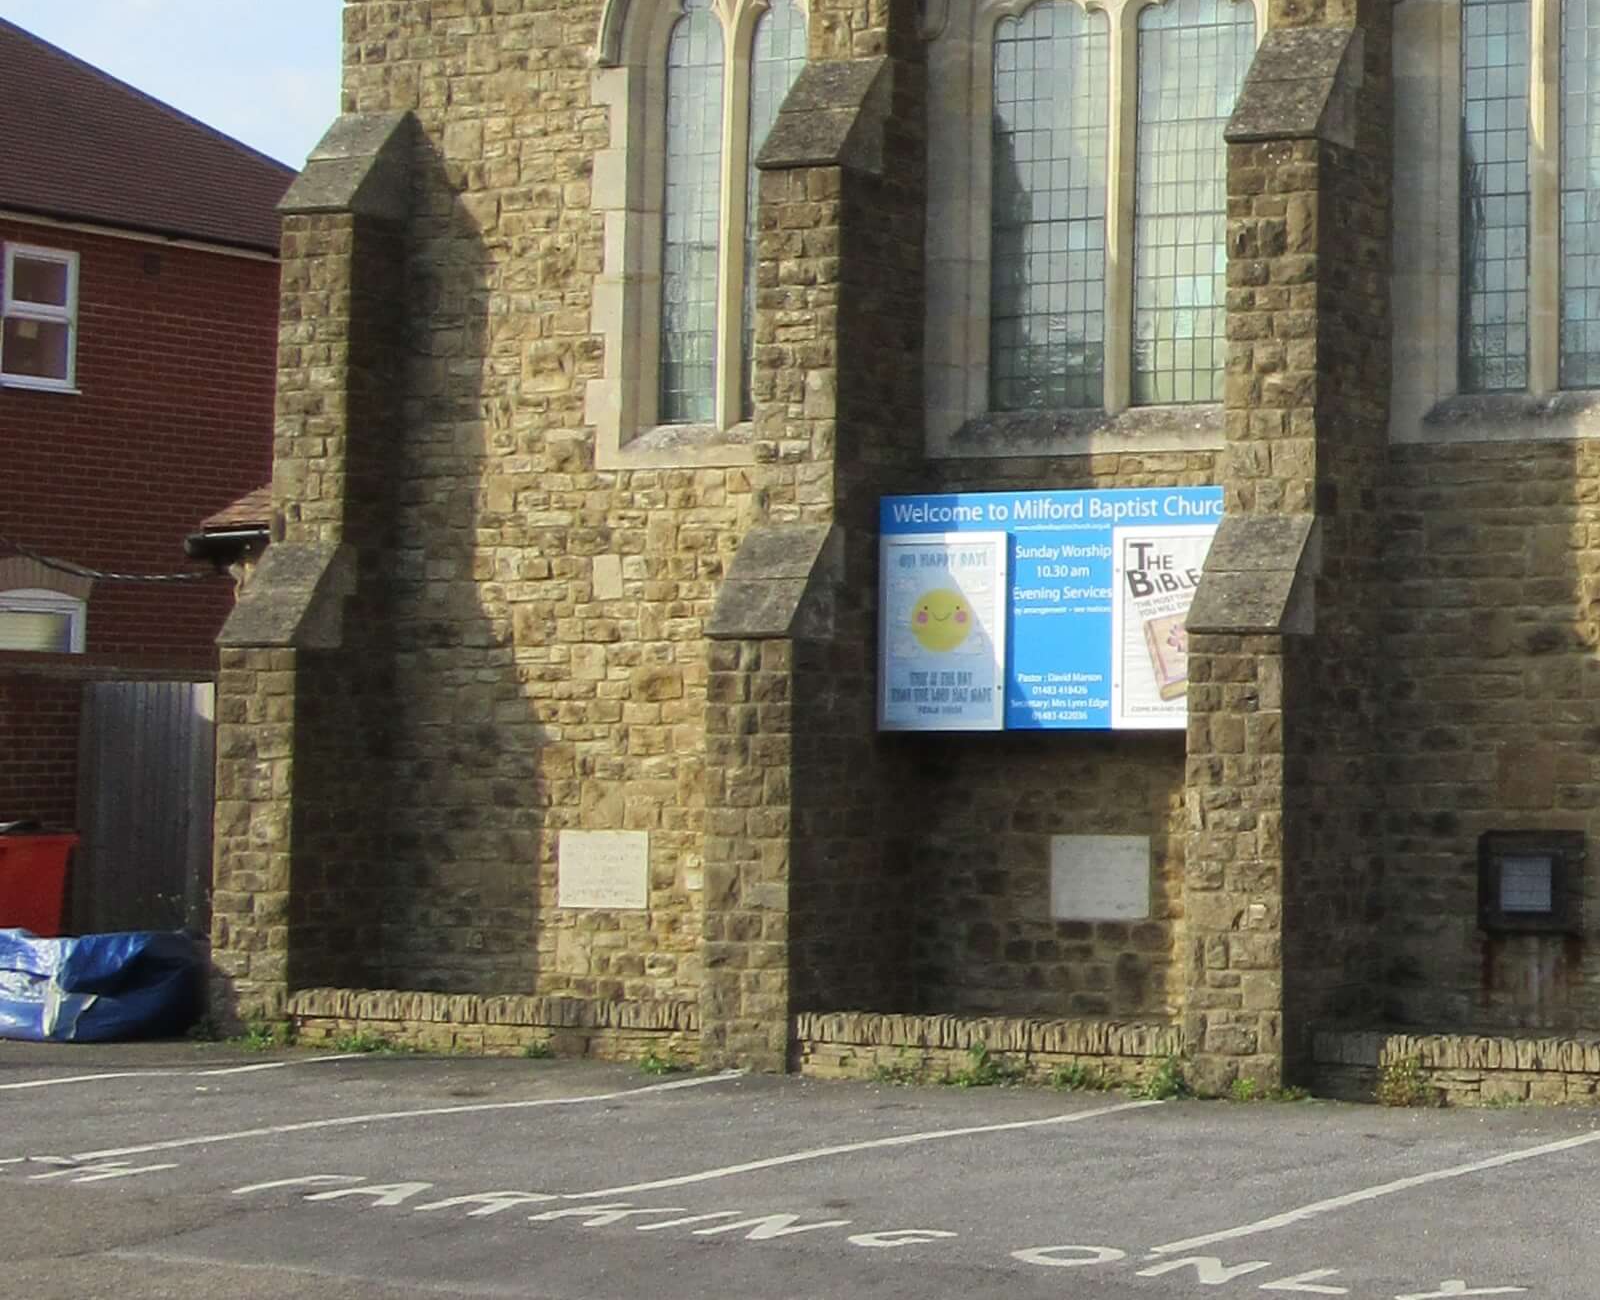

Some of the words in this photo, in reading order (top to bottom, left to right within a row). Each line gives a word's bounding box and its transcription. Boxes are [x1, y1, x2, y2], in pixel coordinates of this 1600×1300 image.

[893, 503, 983, 523] Welcome
[988, 503, 1009, 521] to
[1013, 497, 1083, 520] Milford
[1090, 496, 1157, 522] Baptist
[1163, 494, 1223, 516] Churc
[1015, 544, 1060, 561] Sunday
[1061, 543, 1112, 561] Worship
[1130, 543, 1173, 570] THE
[1036, 564, 1069, 578] 10.30
[1071, 567, 1090, 578] am
[1014, 586, 1060, 603] Evening
[1063, 585, 1112, 599] Services
[1127, 568, 1200, 598] BIBLE
[1047, 672, 1072, 682] David
[231, 1175, 957, 1247] PARKING
[1009, 1244, 1530, 1300] ONLY
